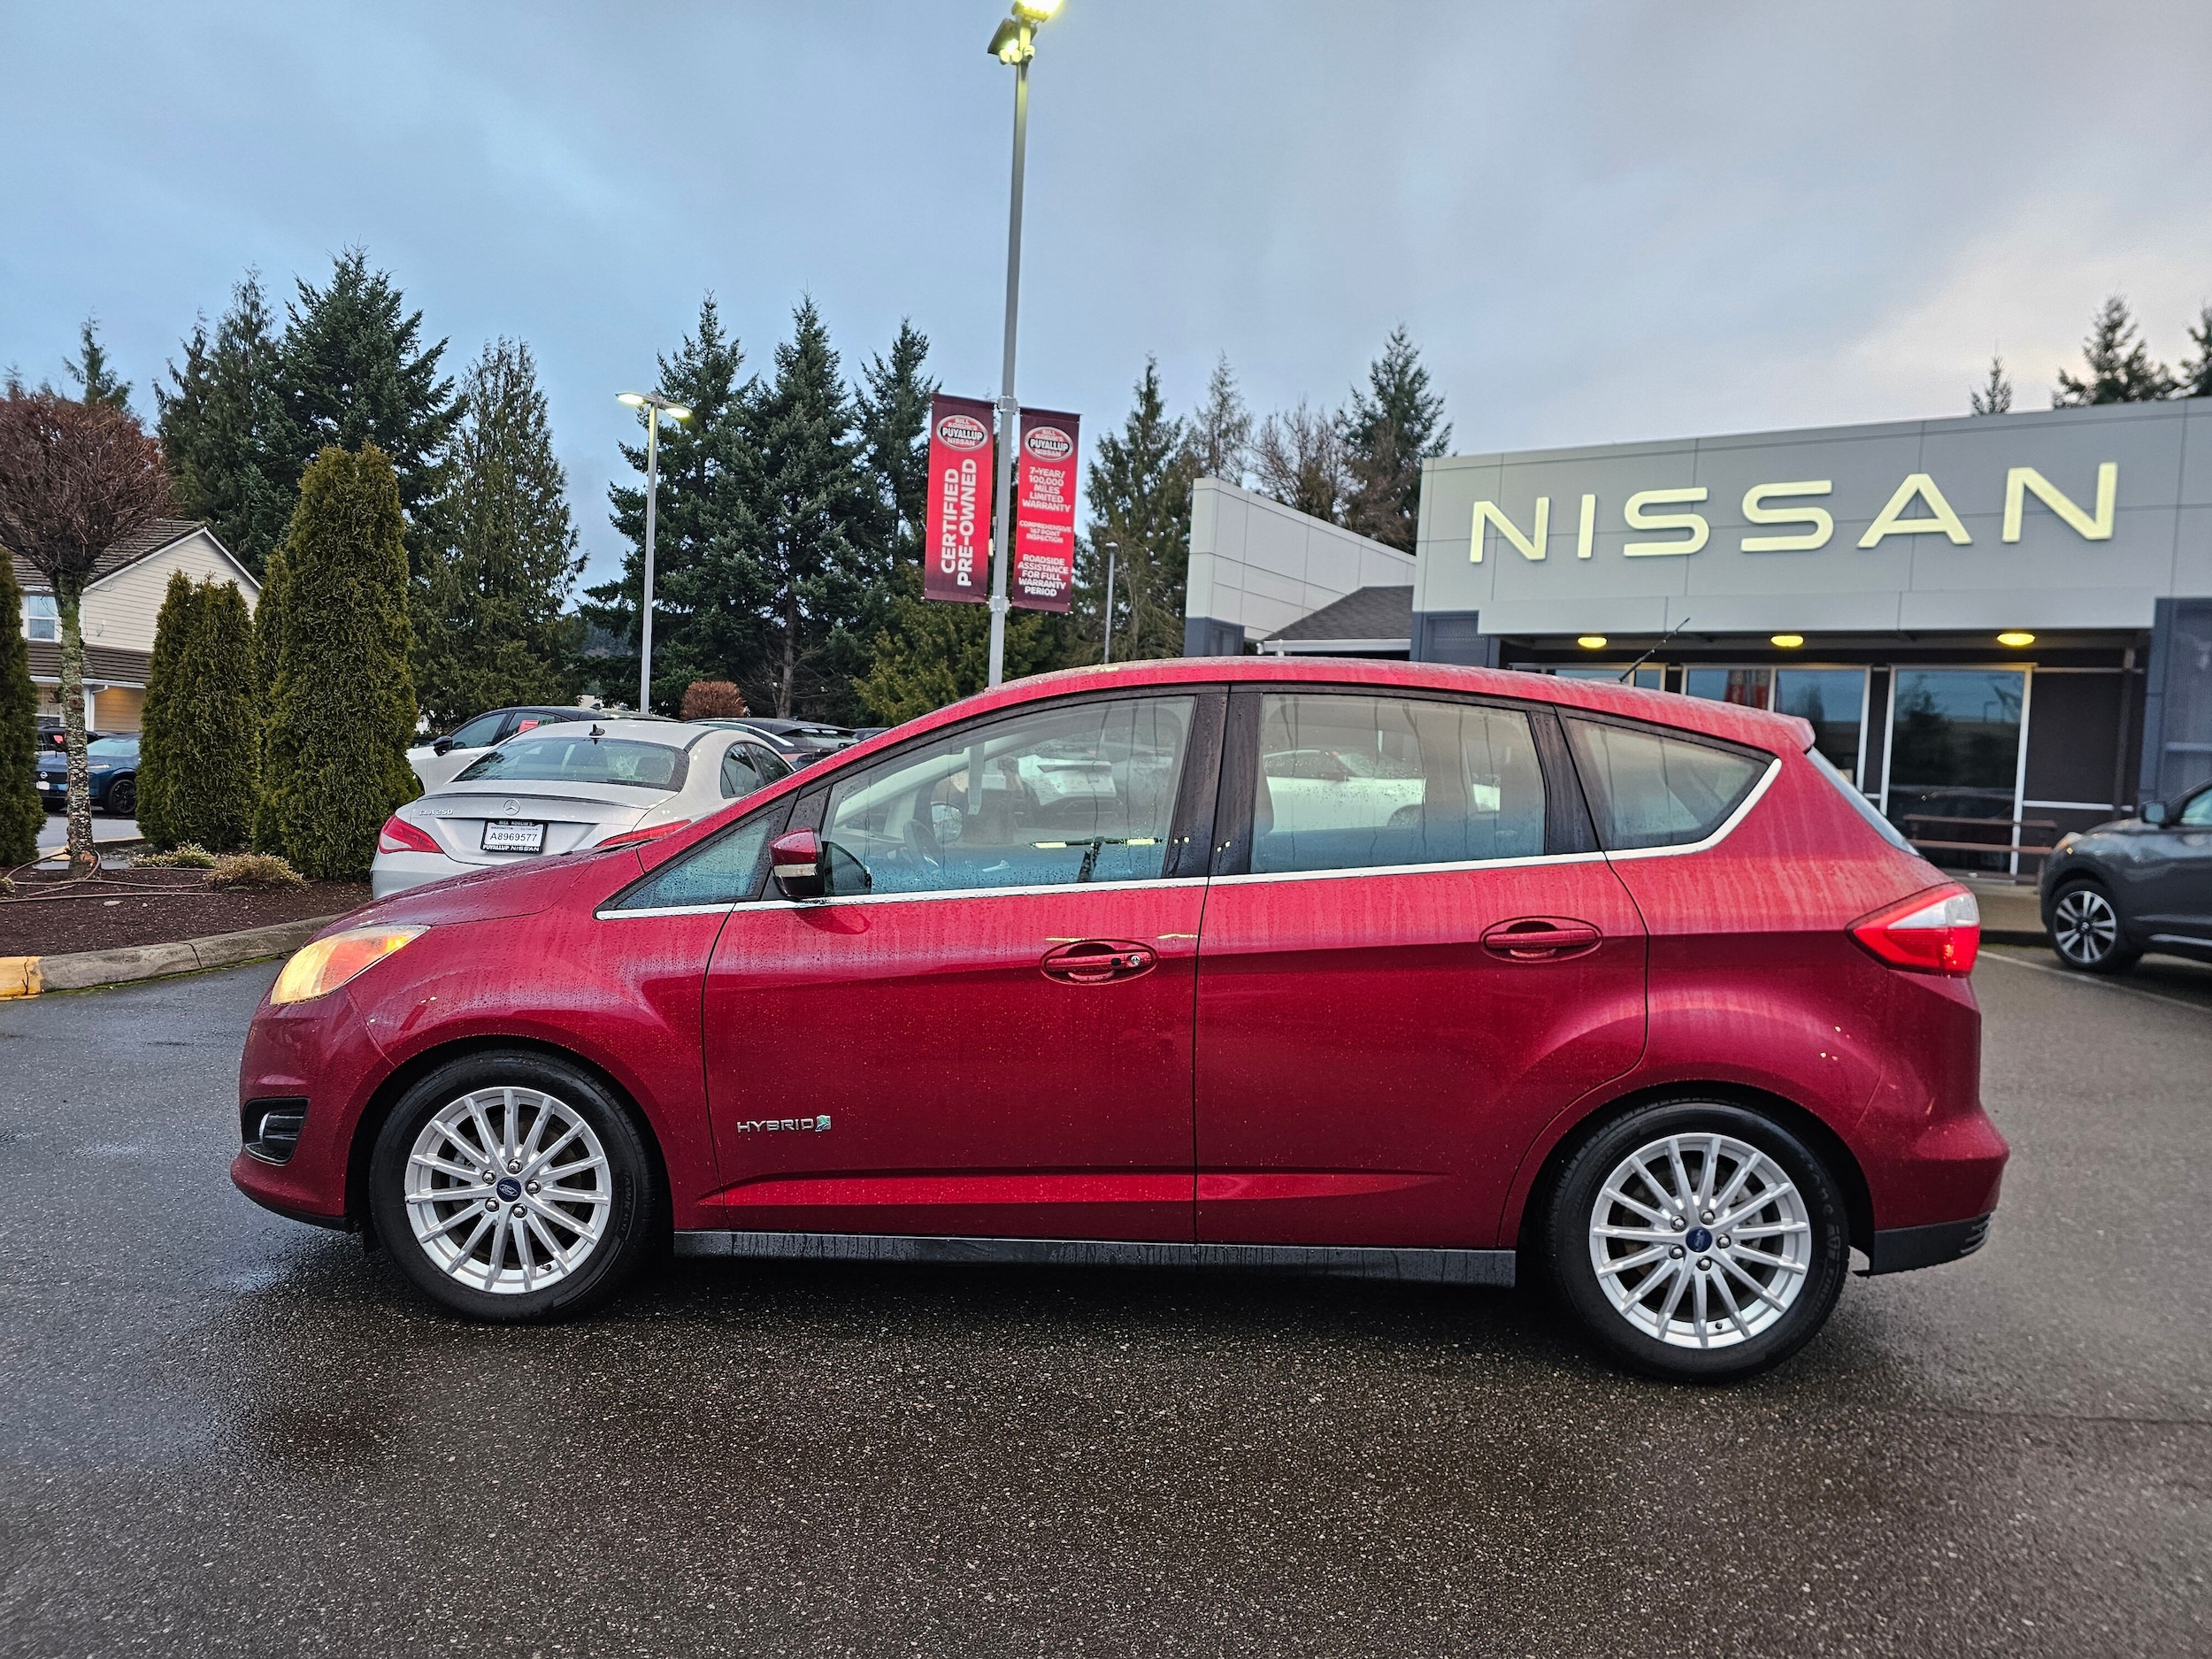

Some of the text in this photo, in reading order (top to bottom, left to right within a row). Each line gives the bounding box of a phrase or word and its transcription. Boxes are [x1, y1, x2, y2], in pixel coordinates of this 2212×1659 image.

[942, 426, 983, 441] PUYALLUP
[947, 437, 975, 446] NISSAN
[1030, 439, 1069, 452] PUYALLUP
[1029, 466, 1065, 479] 7-YEAR/
[1033, 484, 1060, 495] MILES
[1029, 492, 1064, 503] LIMITED
[1022, 498, 1071, 512] WARRANTY
[1470, 463, 2118, 563] NISSAN
[941, 468, 959, 573] CERTIFIED
[956, 458, 977, 587] PRE-OWNED
[1019, 520, 1071, 533] COMPREHENSIVE
[1026, 533, 1064, 543] INSPECTION
[1023, 554, 1065, 565] ROADSIDE
[1018, 561, 1069, 574] ASSISTANCE
[1022, 569, 1062, 581] FOR FULL
[1018, 577, 1066, 590] WARRANTY
[1025, 586, 1057, 597] PERIOD
[490, 833, 538, 841] A8969577
[737, 1118, 814, 1133] HYBRID
